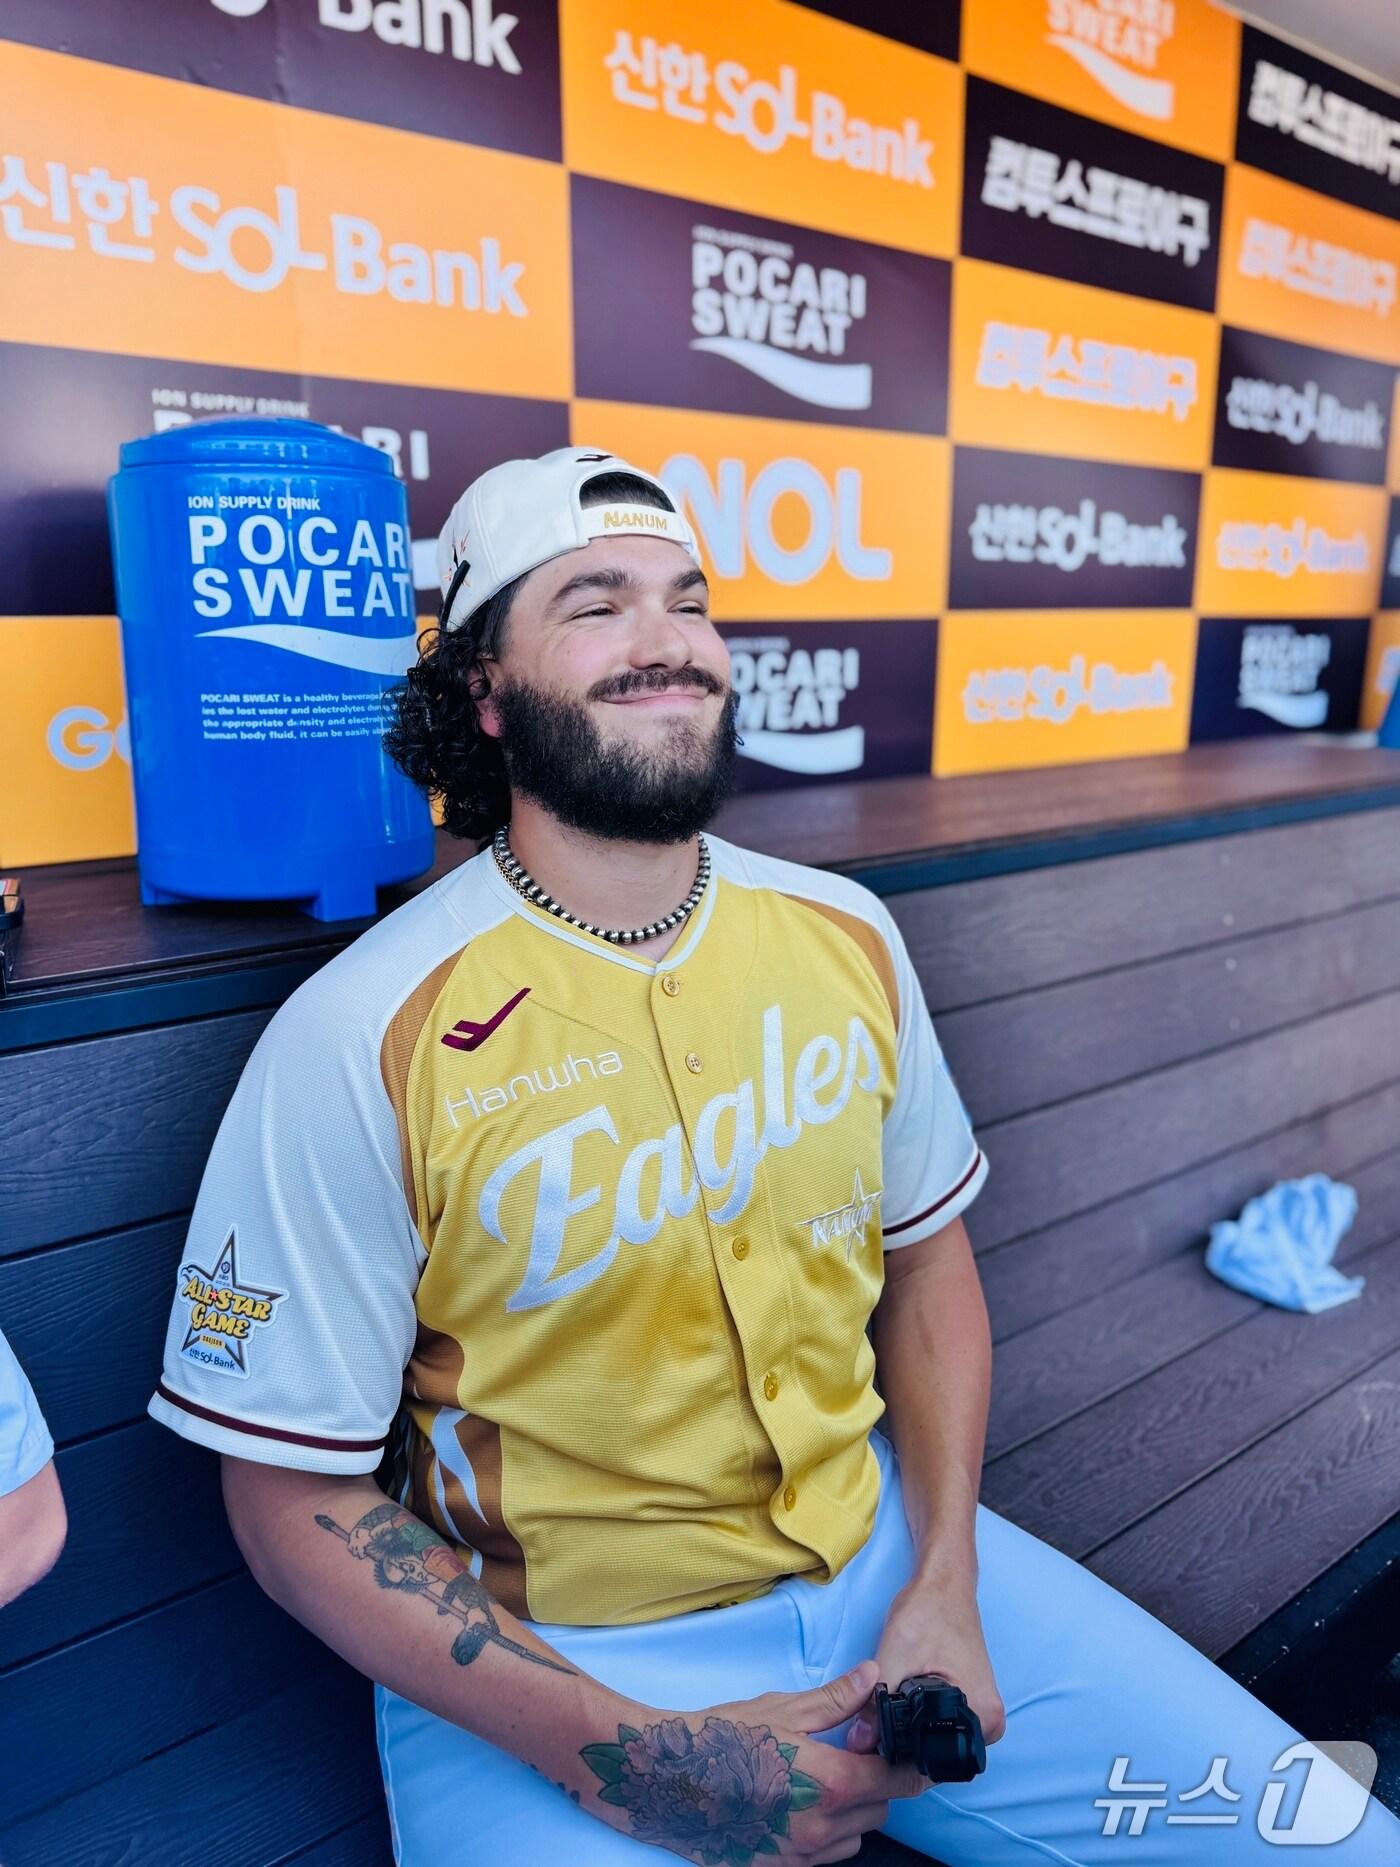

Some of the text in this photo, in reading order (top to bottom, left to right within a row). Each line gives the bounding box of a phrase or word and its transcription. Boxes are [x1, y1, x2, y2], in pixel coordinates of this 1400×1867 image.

[604, 30, 711, 124] 신한
[811, 91, 936, 188] Bank
[0, 154, 528, 317] 신한 SOL Bank
[692, 240, 867, 320] POCARI
[692, 287, 853, 356] SWEAT
[188, 496, 320, 511] ION SUPPLY DRINK
[657, 453, 893, 585] NOL
[192, 568, 410, 617] SWEAT
[730, 648, 860, 692] OCARI
[201, 694, 240, 703] POCARI
[243, 694, 280, 703] SWEAT
[283, 694, 292, 702] is
[304, 693, 339, 703] healthy
[218, 707, 234, 715] the
[237, 707, 256, 715] lost
[291, 706, 310, 714] and
[312, 705, 365, 714] electrolytes
[736, 684, 846, 731] WEAT
[203, 719, 219, 727] the
[222, 718, 283, 729] appropriate
[328, 717, 346, 725] and
[204, 731, 238, 739] human
[240, 731, 266, 740] body
[331, 729, 343, 737] be
[345, 728, 369, 736] easily
[444, 1050, 624, 1129] Hanwha
[478, 1004, 879, 1313] Eagles
[191, 1302, 249, 1339] GAME
[214, 1356, 236, 1370] Bank
